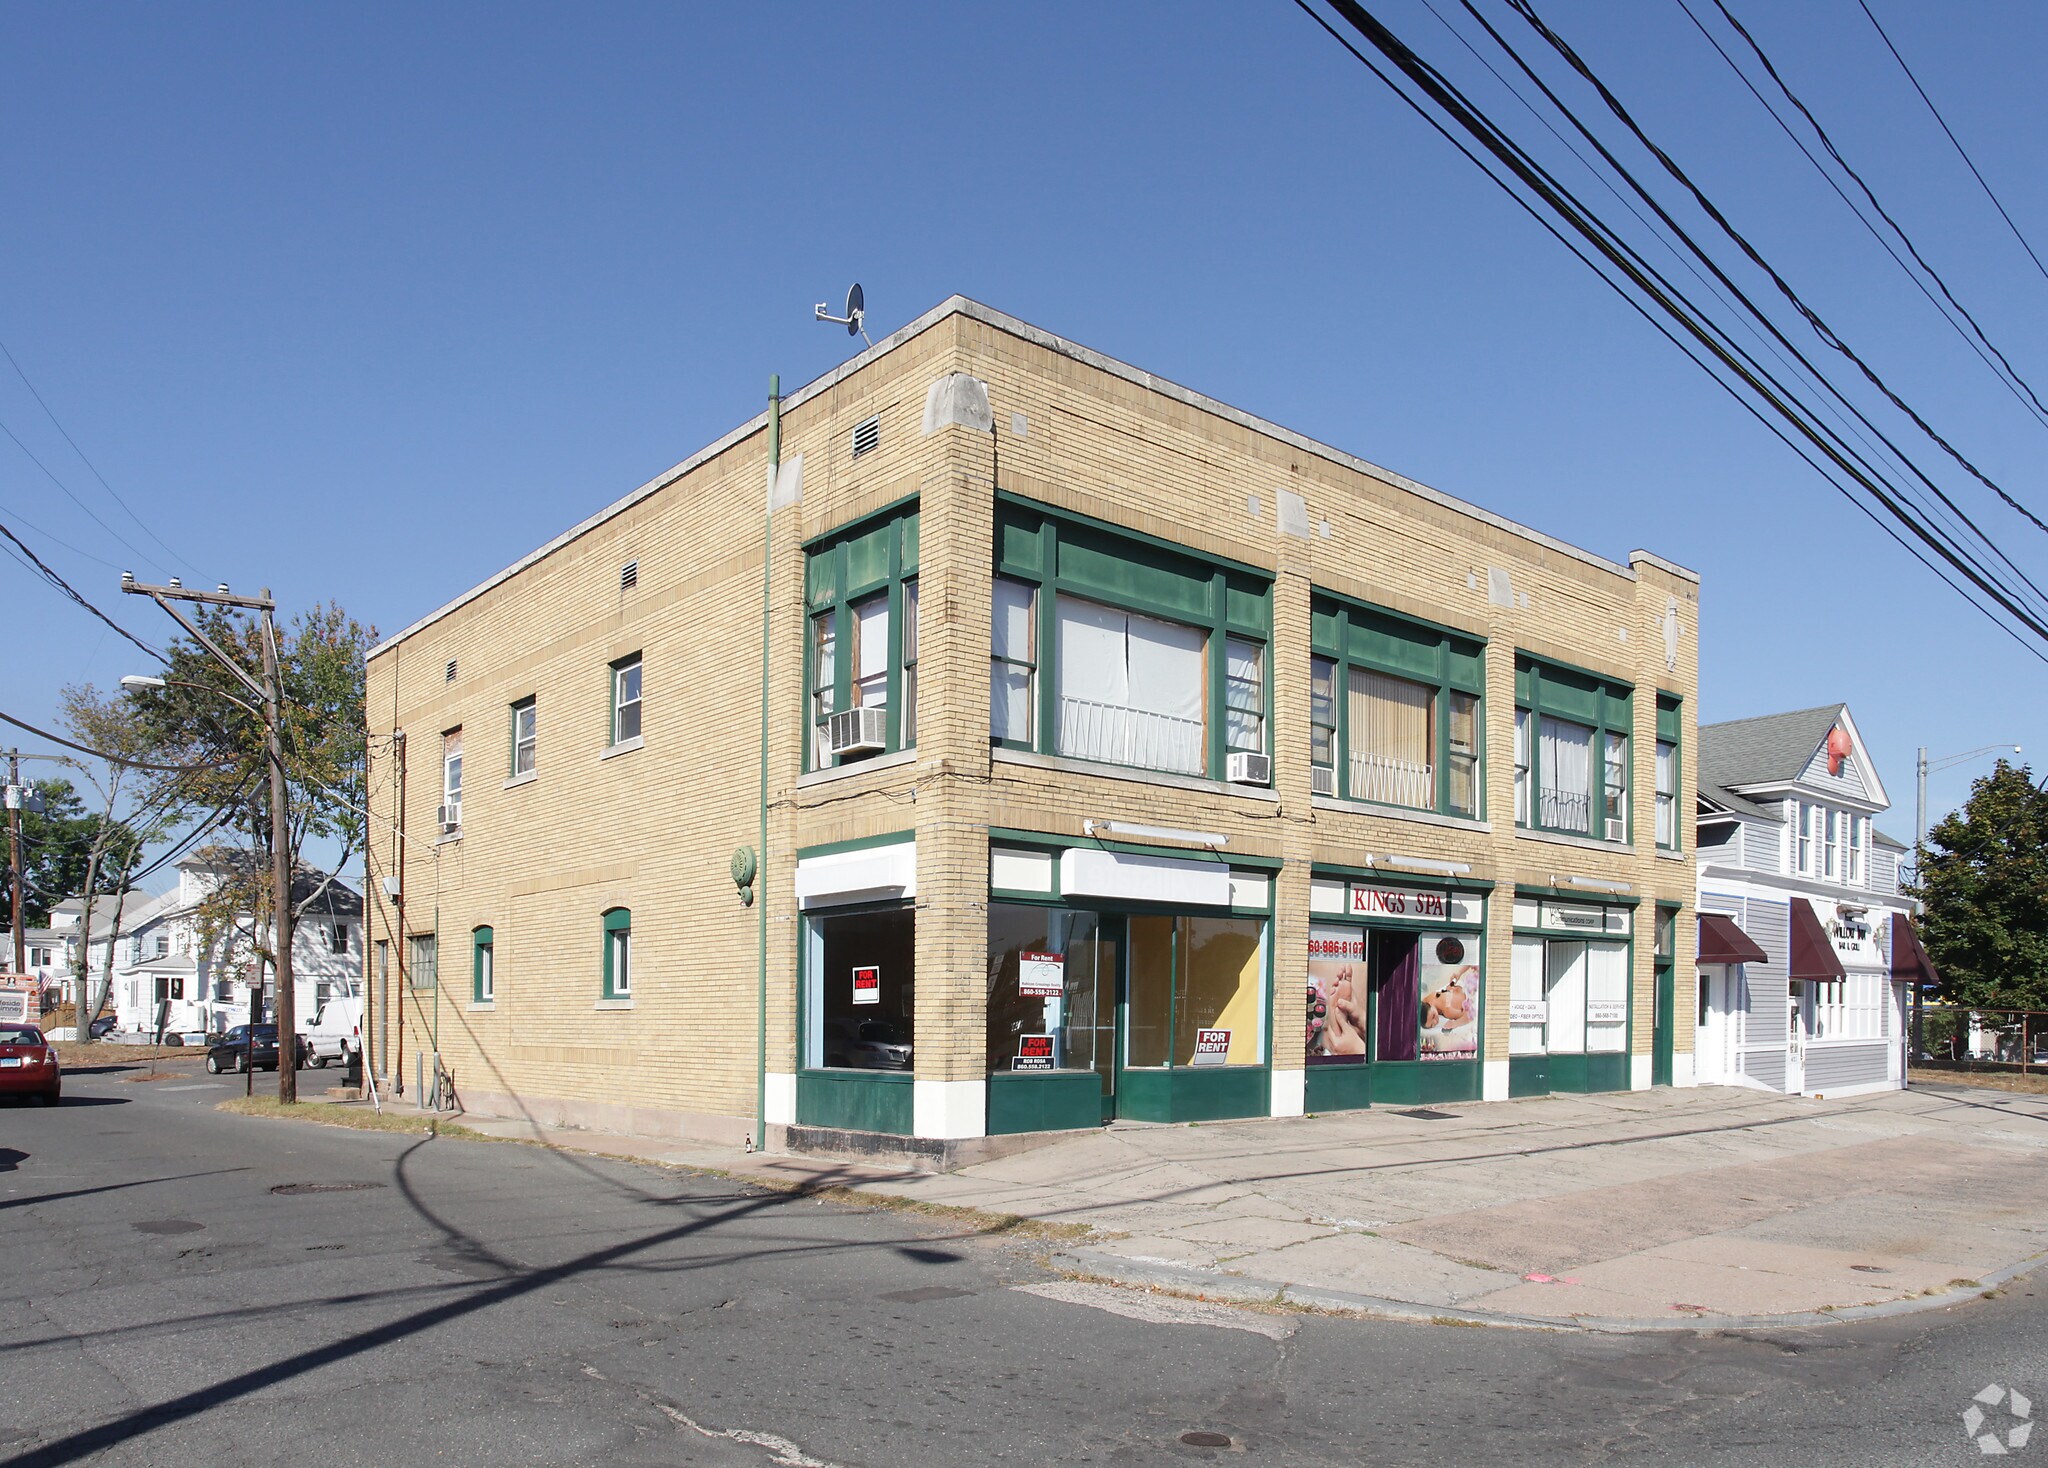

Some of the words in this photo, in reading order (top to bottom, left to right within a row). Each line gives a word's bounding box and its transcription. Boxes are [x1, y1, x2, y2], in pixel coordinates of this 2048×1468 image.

[1353, 887, 1406, 914] KINGS
[1415, 892, 1445, 916] SPA
[1041, 954, 1054, 962] Rent
[858, 970, 873, 980] FOR
[855, 979, 877, 989] RENT
[1023, 988, 1059, 996] 860-558-2122
[1203, 1032, 1226, 1042] FOR
[1027, 1038, 1047, 1047] FOR
[1198, 1042, 1228, 1052] RENT
[1021, 1047, 1051, 1056] RENT
